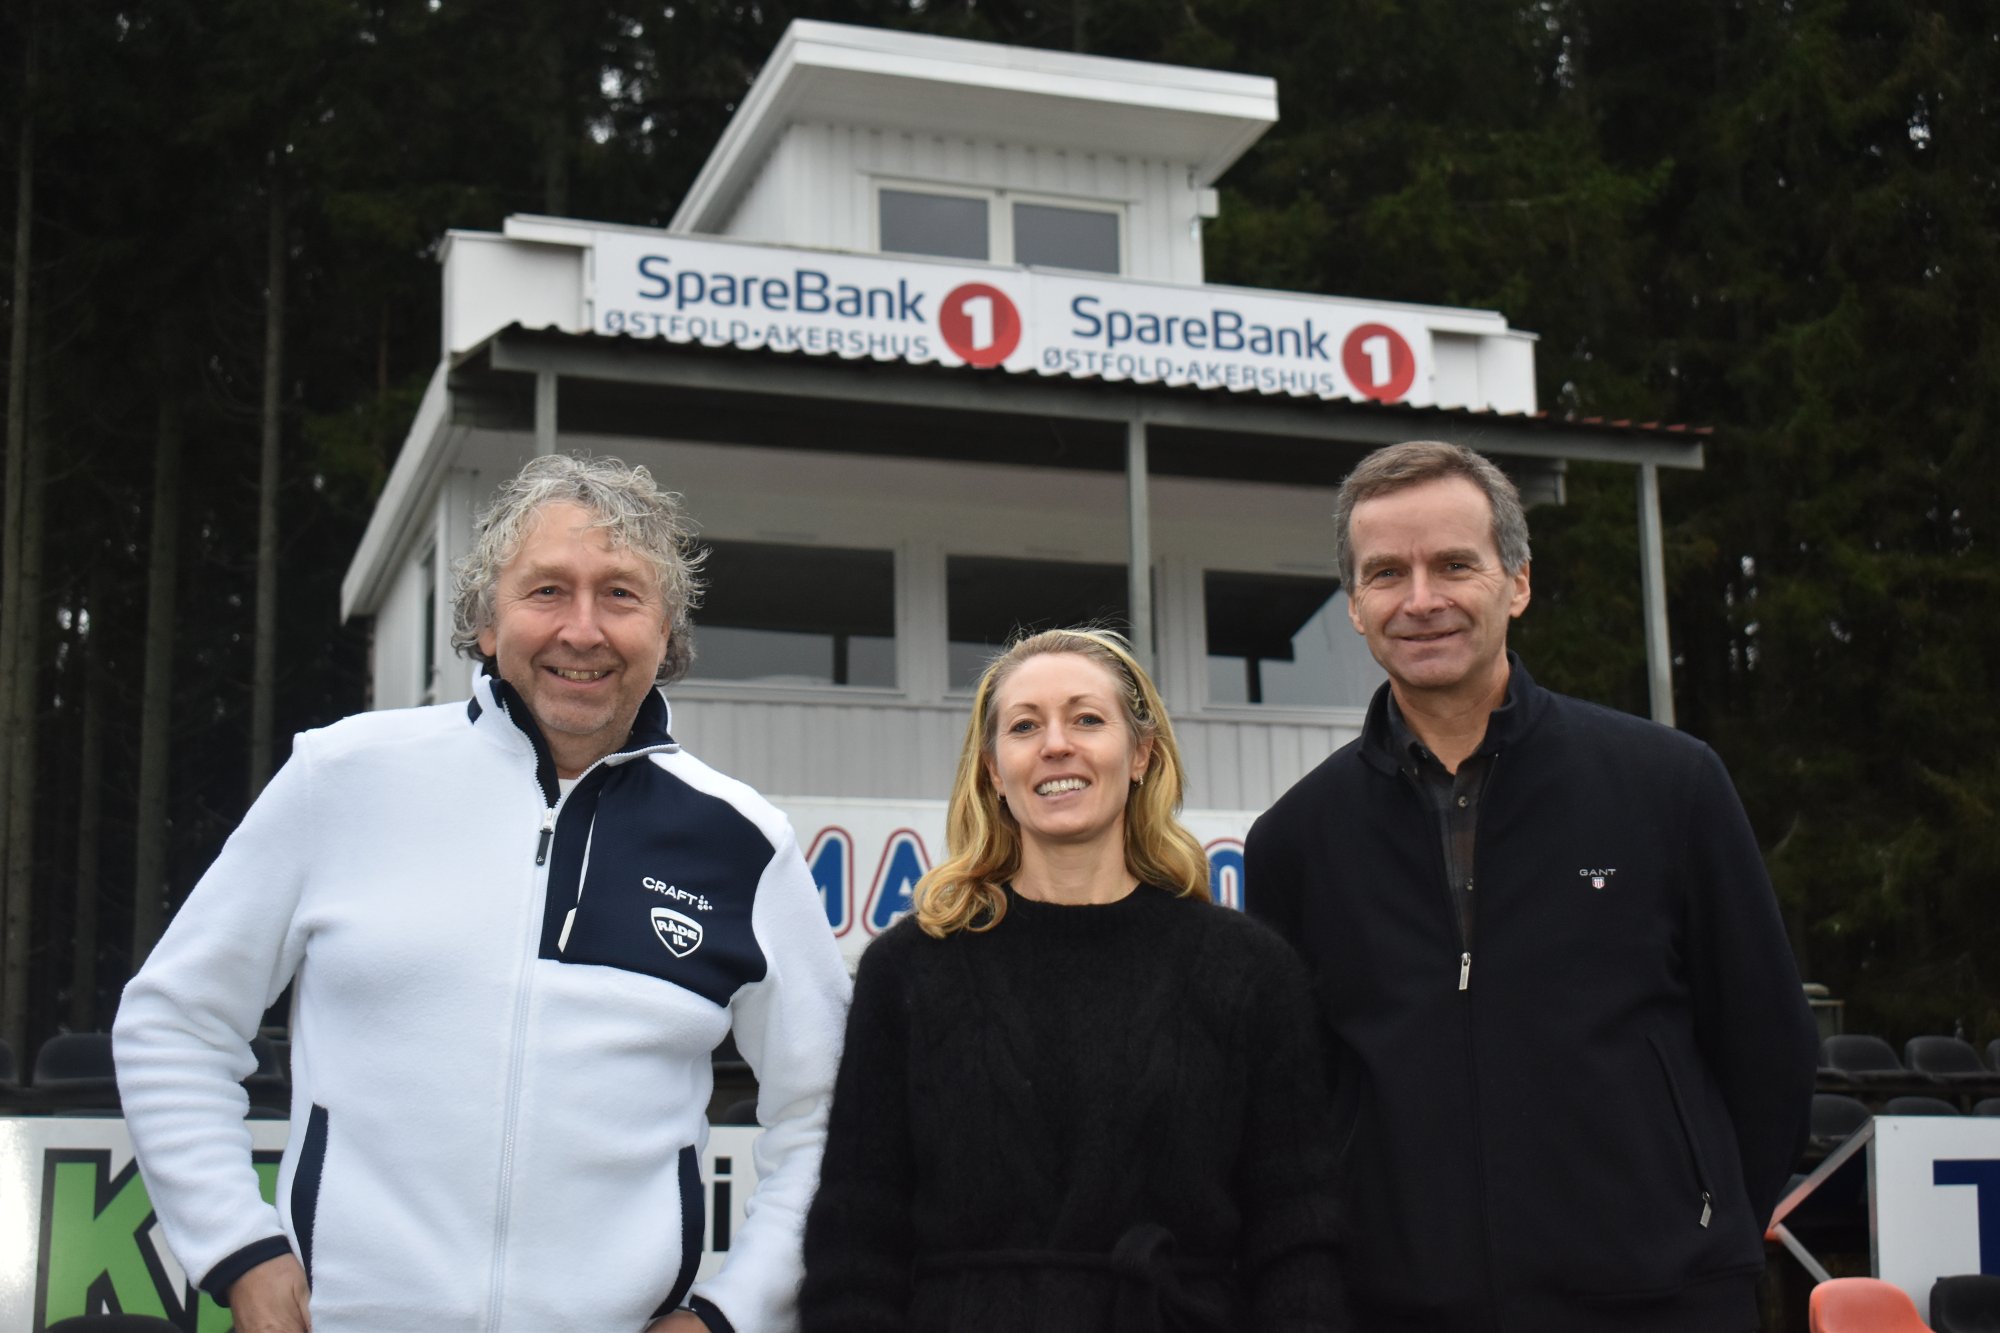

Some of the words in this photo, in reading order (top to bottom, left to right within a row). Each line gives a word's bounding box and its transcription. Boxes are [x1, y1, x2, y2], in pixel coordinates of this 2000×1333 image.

[637, 254, 926, 323] SpareBank
[961, 295, 996, 352] 1
[1070, 295, 1332, 362] SpareBank
[1360, 334, 1394, 389] 1
[1579, 868, 1617, 877] GANT
[642, 876, 698, 906] CRAFT
[656, 919, 698, 941] RÅDE
[672, 933, 688, 947] IL
